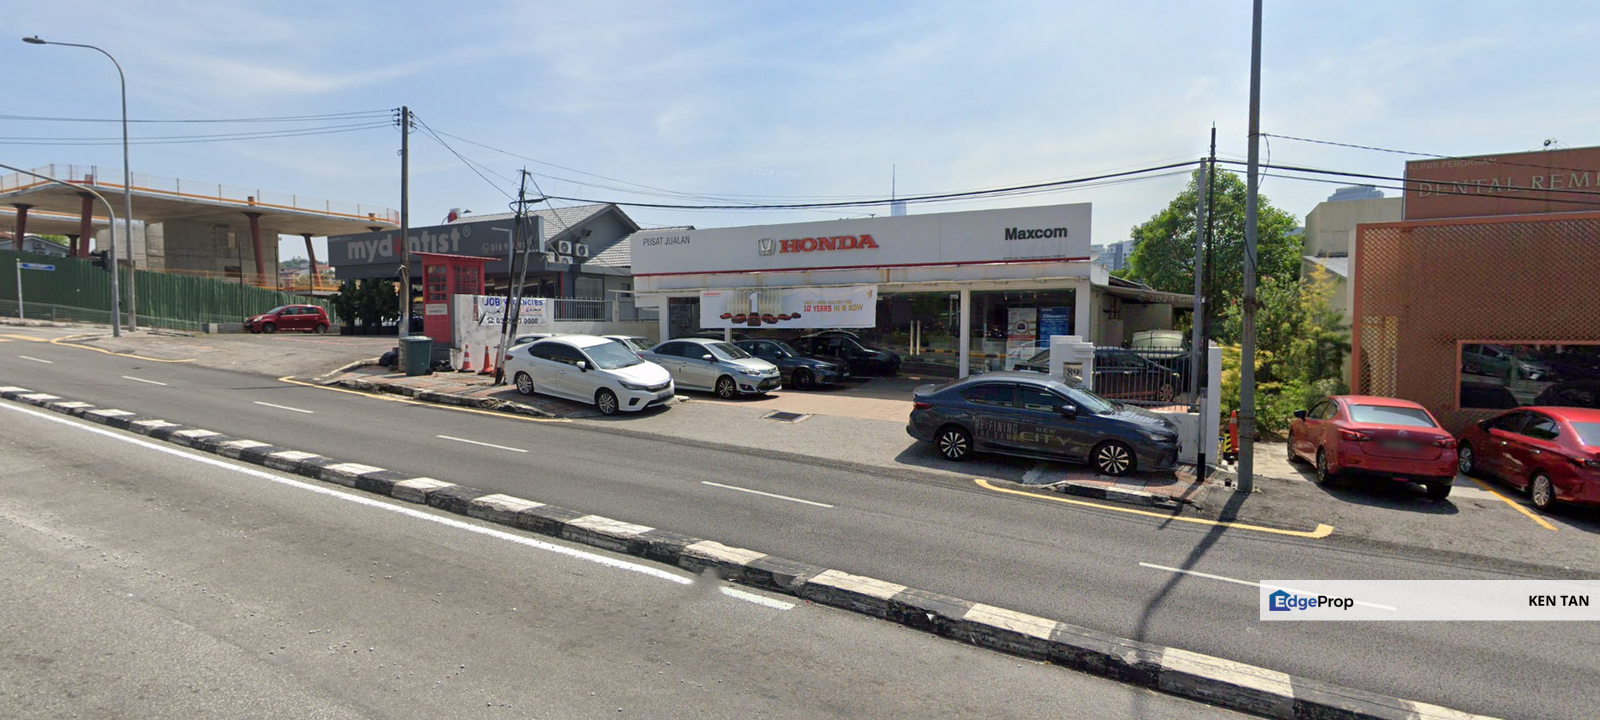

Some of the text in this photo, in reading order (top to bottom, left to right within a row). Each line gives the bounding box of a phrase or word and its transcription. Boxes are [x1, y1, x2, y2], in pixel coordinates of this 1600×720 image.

[1409, 161, 1439, 171] KLINIK
[1419, 177, 1518, 198] DENTAL
[1005, 227, 1068, 241] Maxcom
[643, 236, 690, 246] PUSAT JUALAN
[779, 234, 879, 254] HONDA
[484, 297, 501, 307] JOB
[523, 317, 539, 325] 0000
[1067, 368, 1080, 376] 89
[1020, 431, 1072, 446] CITY
